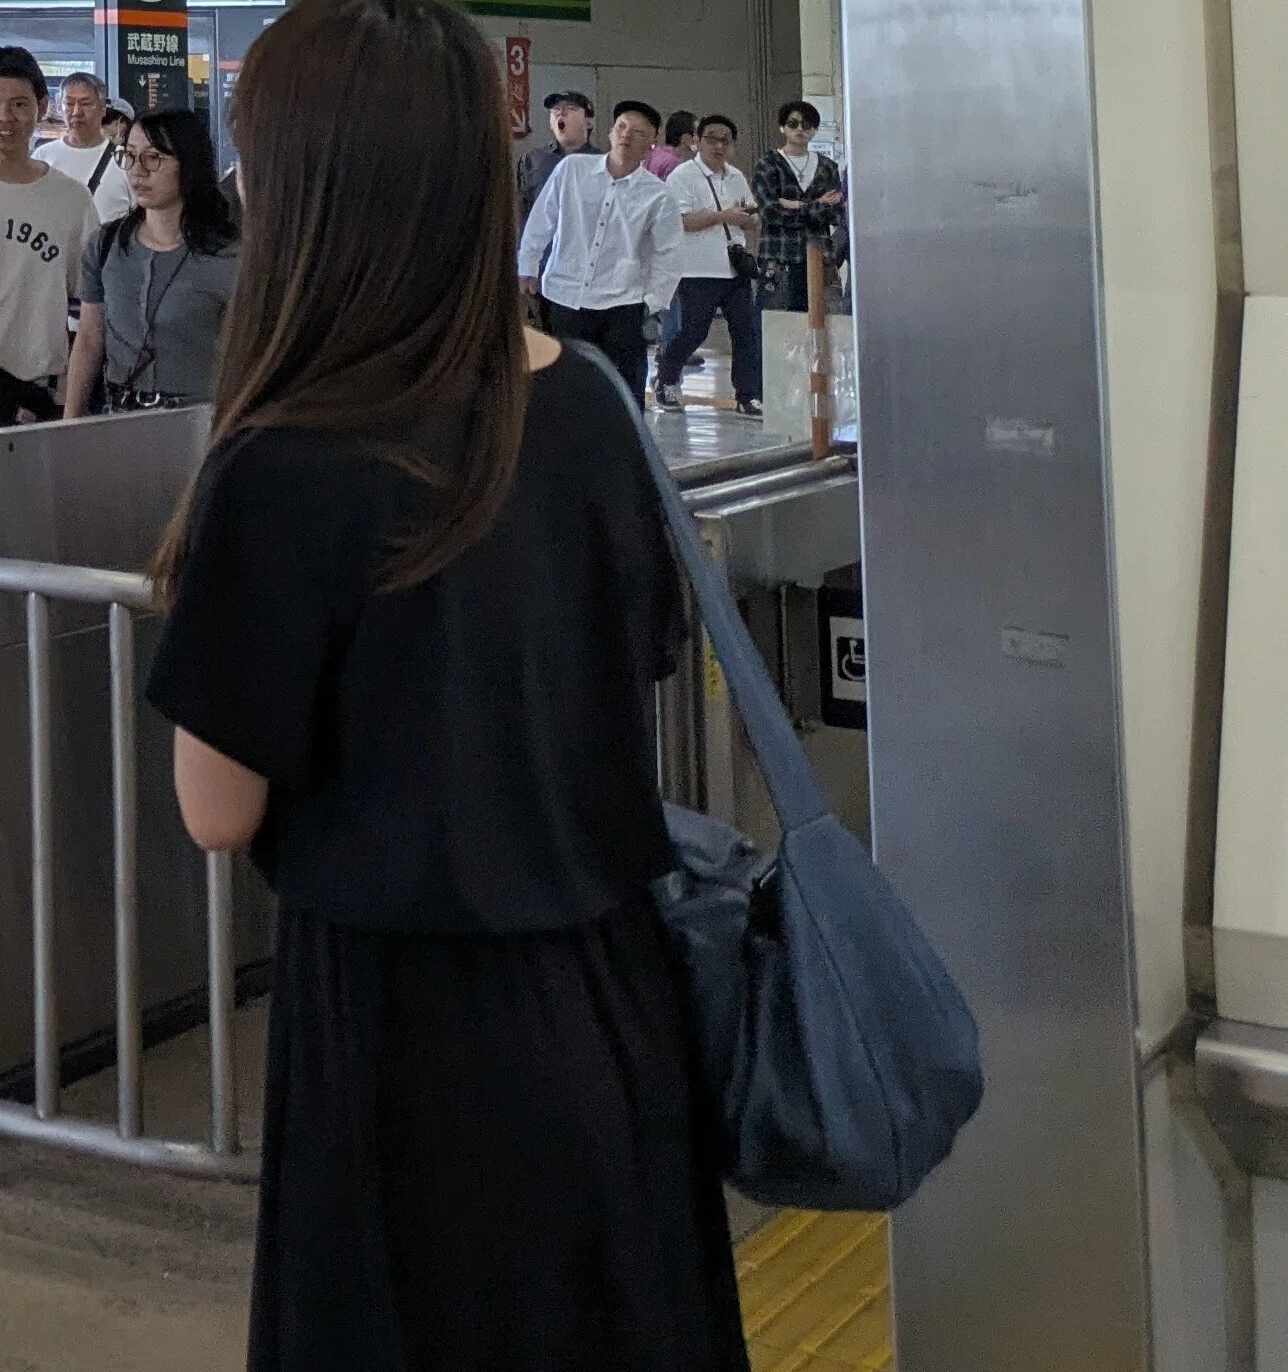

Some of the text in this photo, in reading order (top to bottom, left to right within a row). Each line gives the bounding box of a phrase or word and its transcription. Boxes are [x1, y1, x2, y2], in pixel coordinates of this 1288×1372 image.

[127, 33, 180, 54] 武蔵野線
[127, 54, 186, 67] Musashino Line
[510, 44, 524, 76] 3
[4, 218, 61, 264] 1969
